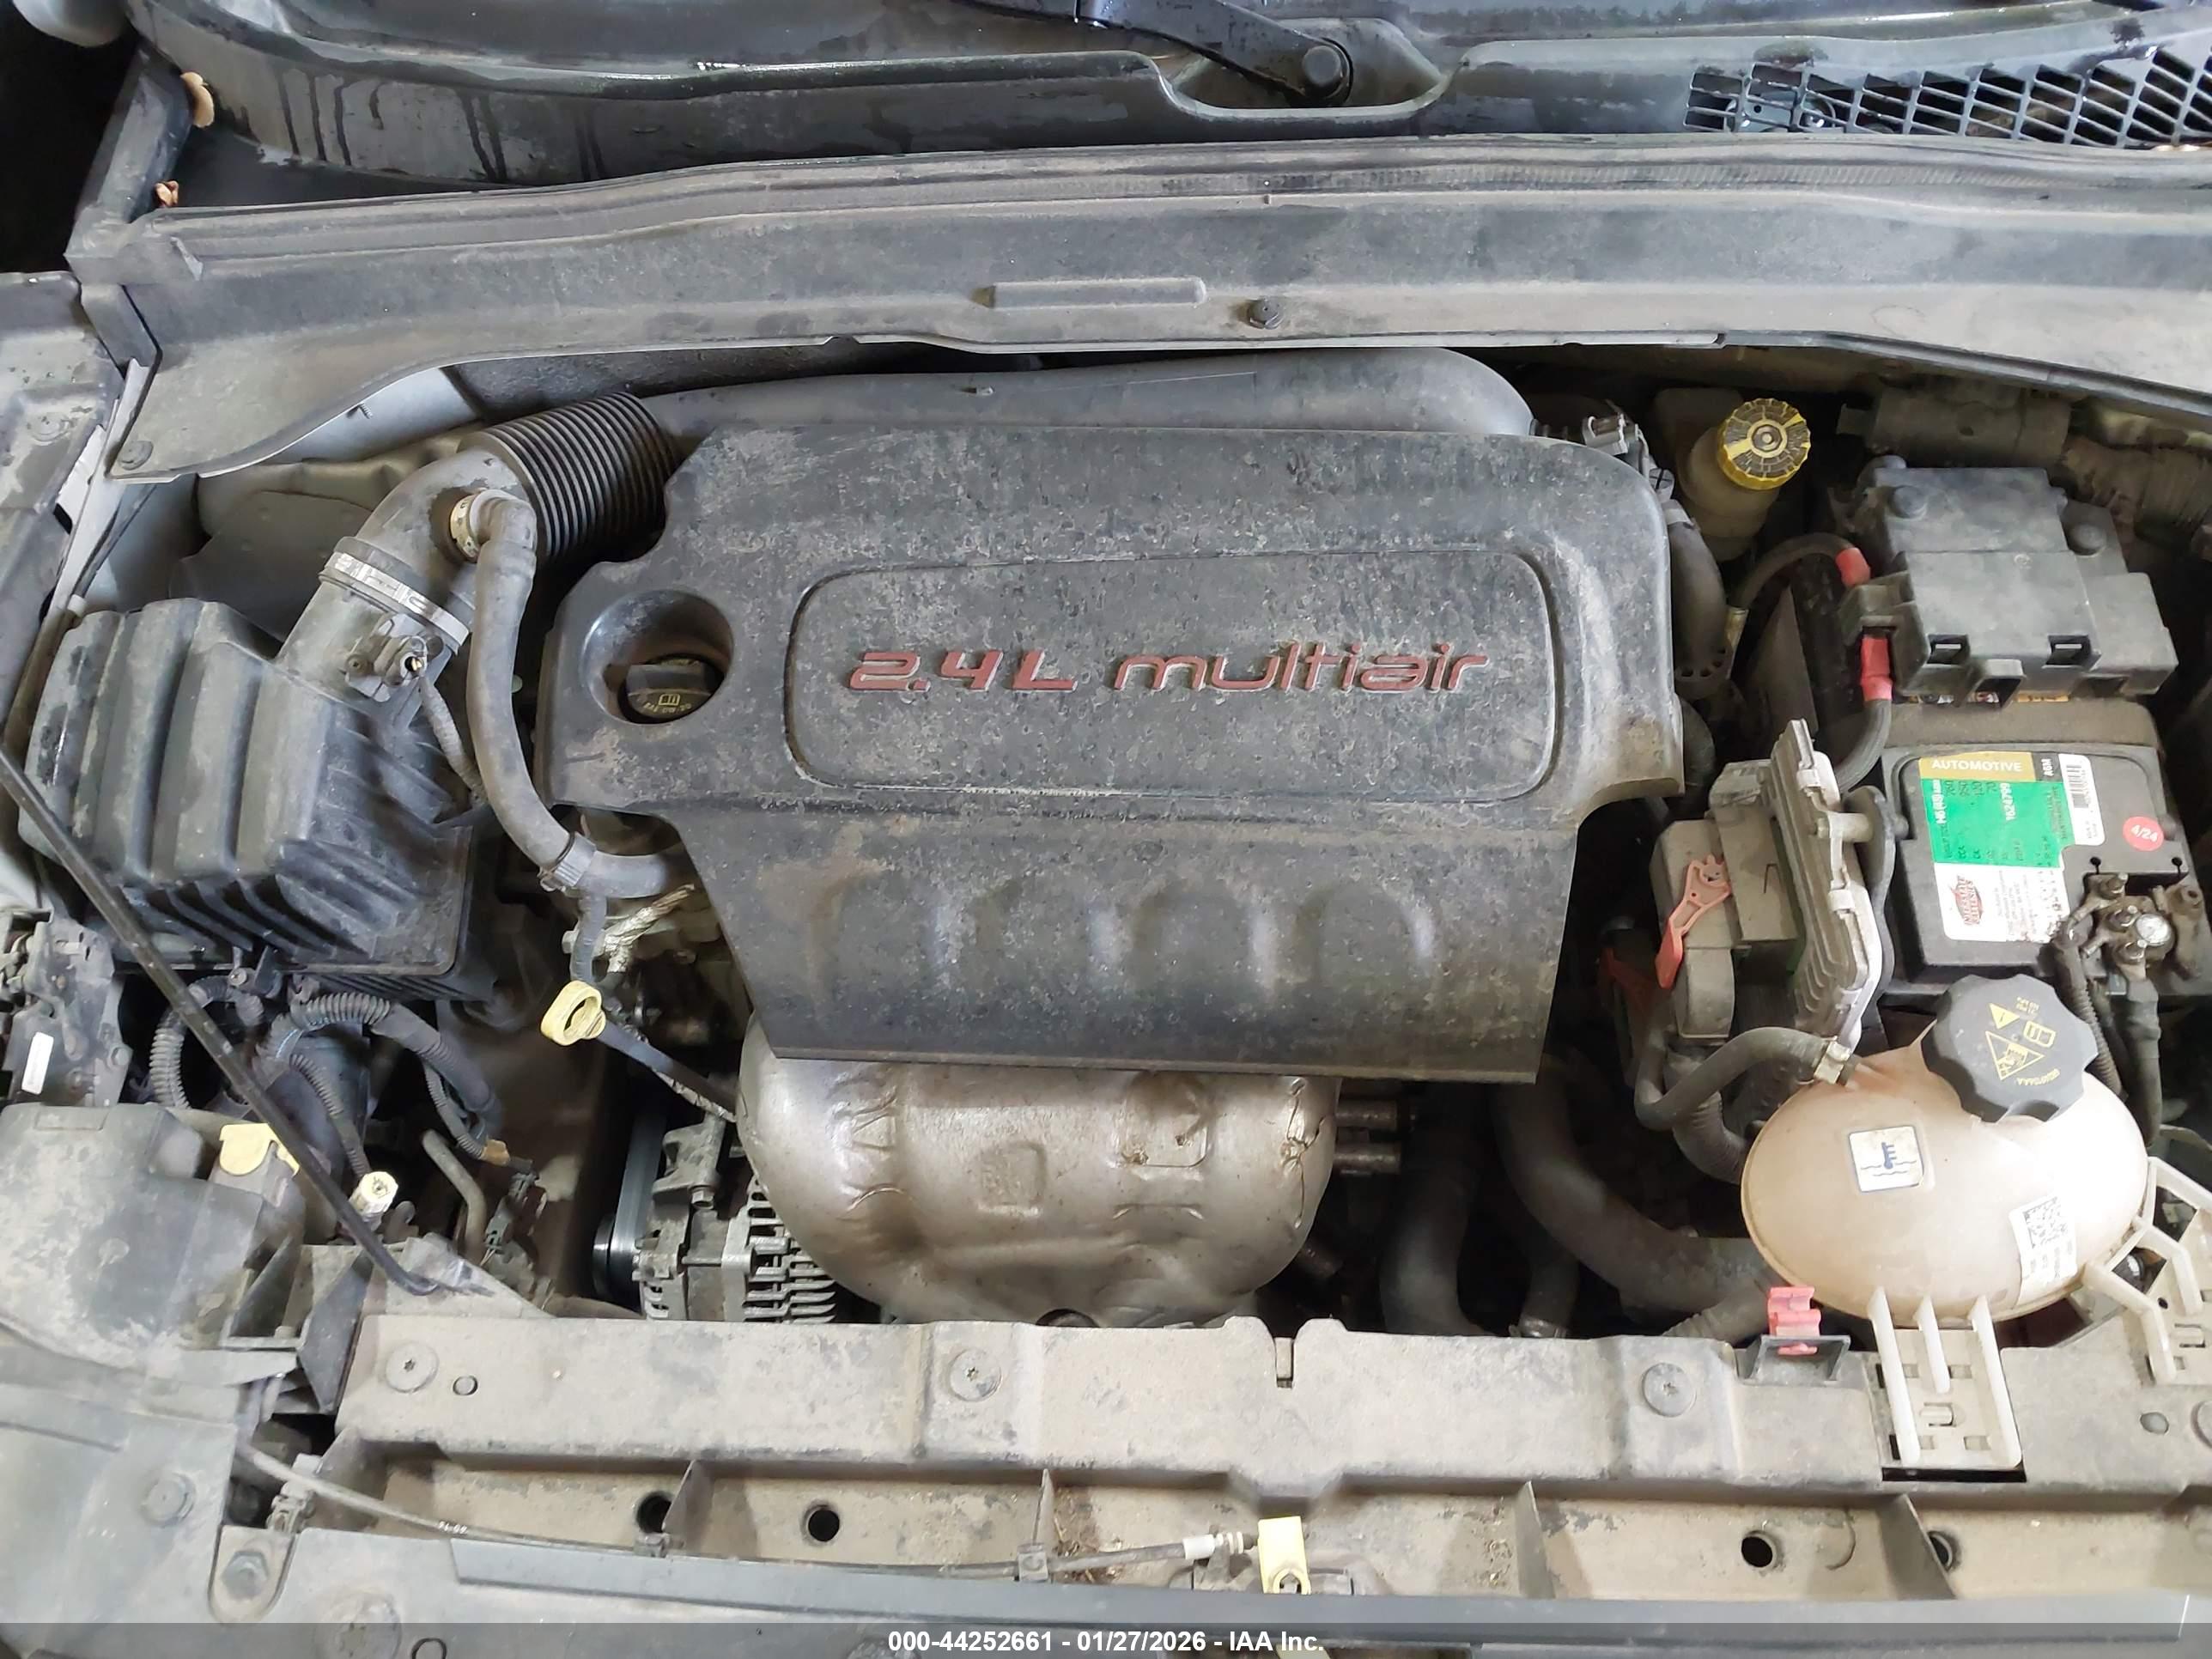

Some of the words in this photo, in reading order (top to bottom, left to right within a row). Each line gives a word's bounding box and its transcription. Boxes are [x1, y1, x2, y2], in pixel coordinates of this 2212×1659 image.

[850, 650, 1077, 692] 2.4L
[1115, 641, 1490, 692] multiair
[1931, 759, 2022, 772] AUTOMOTIVE
[2040, 758, 2055, 777] AGM
[2130, 824, 2158, 842] 4/24
